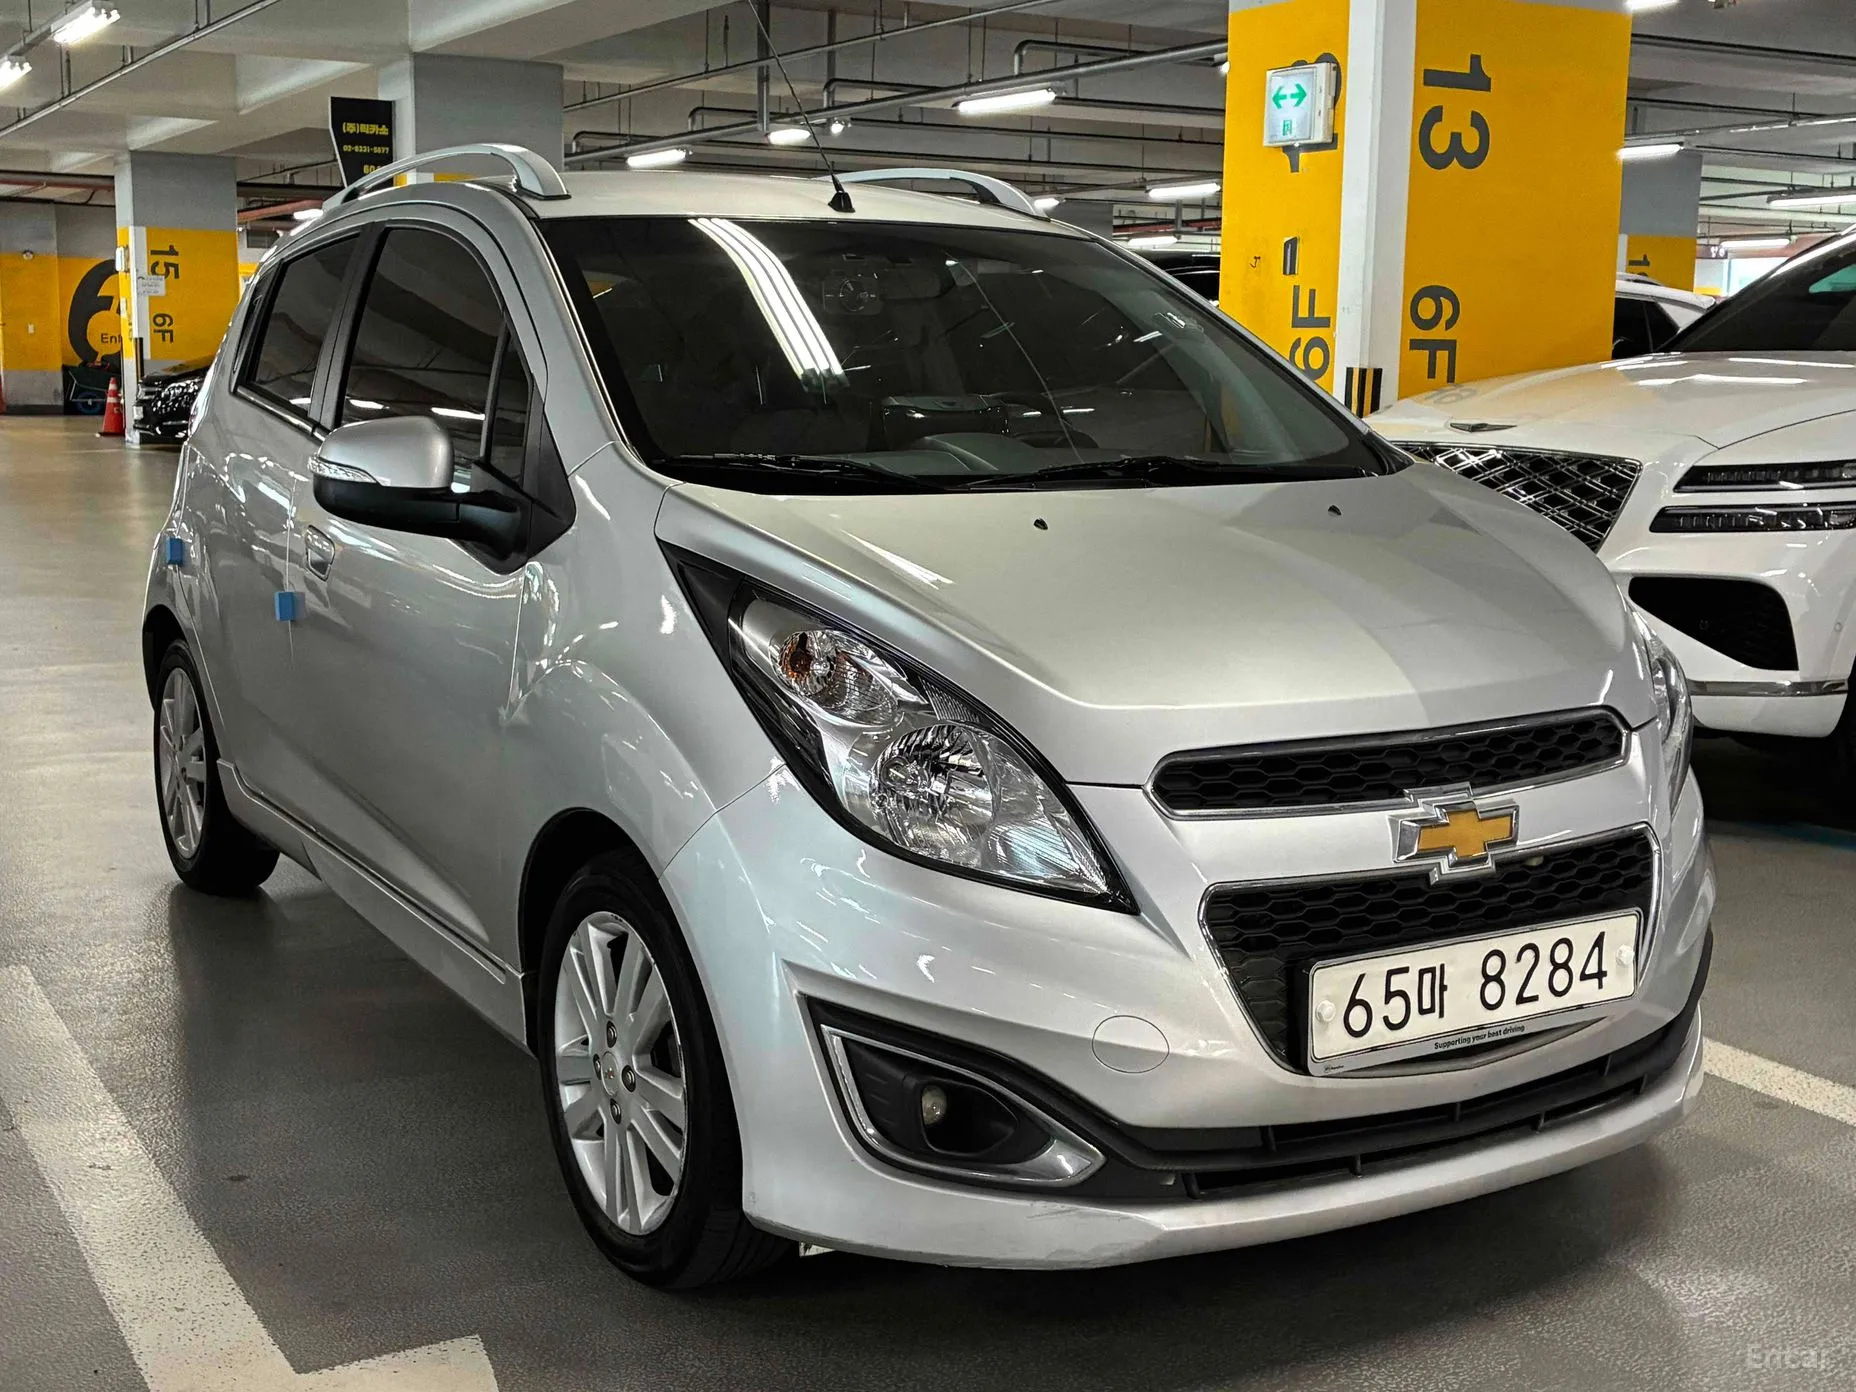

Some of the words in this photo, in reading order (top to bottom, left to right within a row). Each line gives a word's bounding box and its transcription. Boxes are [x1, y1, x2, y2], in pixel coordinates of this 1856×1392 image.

[1418, 54, 1492, 170] 13
[150, 244, 179, 279] 15
[152, 313, 174, 343] 6F
[1409, 284, 1461, 384] 6F
[1343, 963, 1448, 1038] 65마
[1479, 931, 1608, 1011] 8284
[1434, 1034, 1471, 1050] Supporting
[1471, 1032, 1486, 1042] your
[1487, 1029, 1502, 1039] best
[1502, 1025, 1525, 1035] driving
